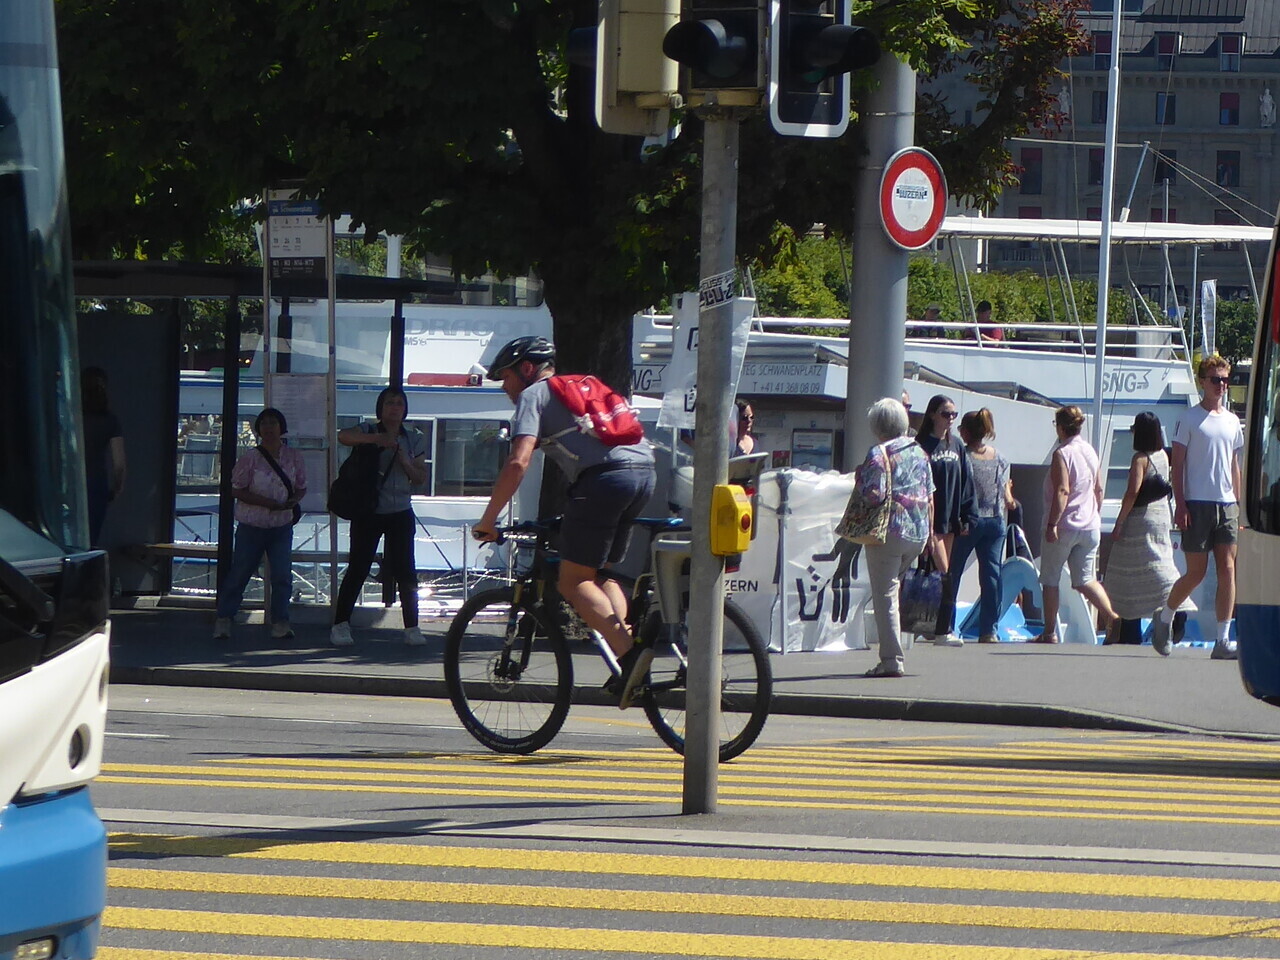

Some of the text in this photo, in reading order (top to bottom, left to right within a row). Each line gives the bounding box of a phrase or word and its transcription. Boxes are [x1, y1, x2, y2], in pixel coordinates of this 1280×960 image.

[758, 364, 822, 377] SCHWANENPLATZ
[633, 369, 652, 391] NG
[1102, 372, 1137, 393] SNG
[724, 579, 758, 592] ZERN
